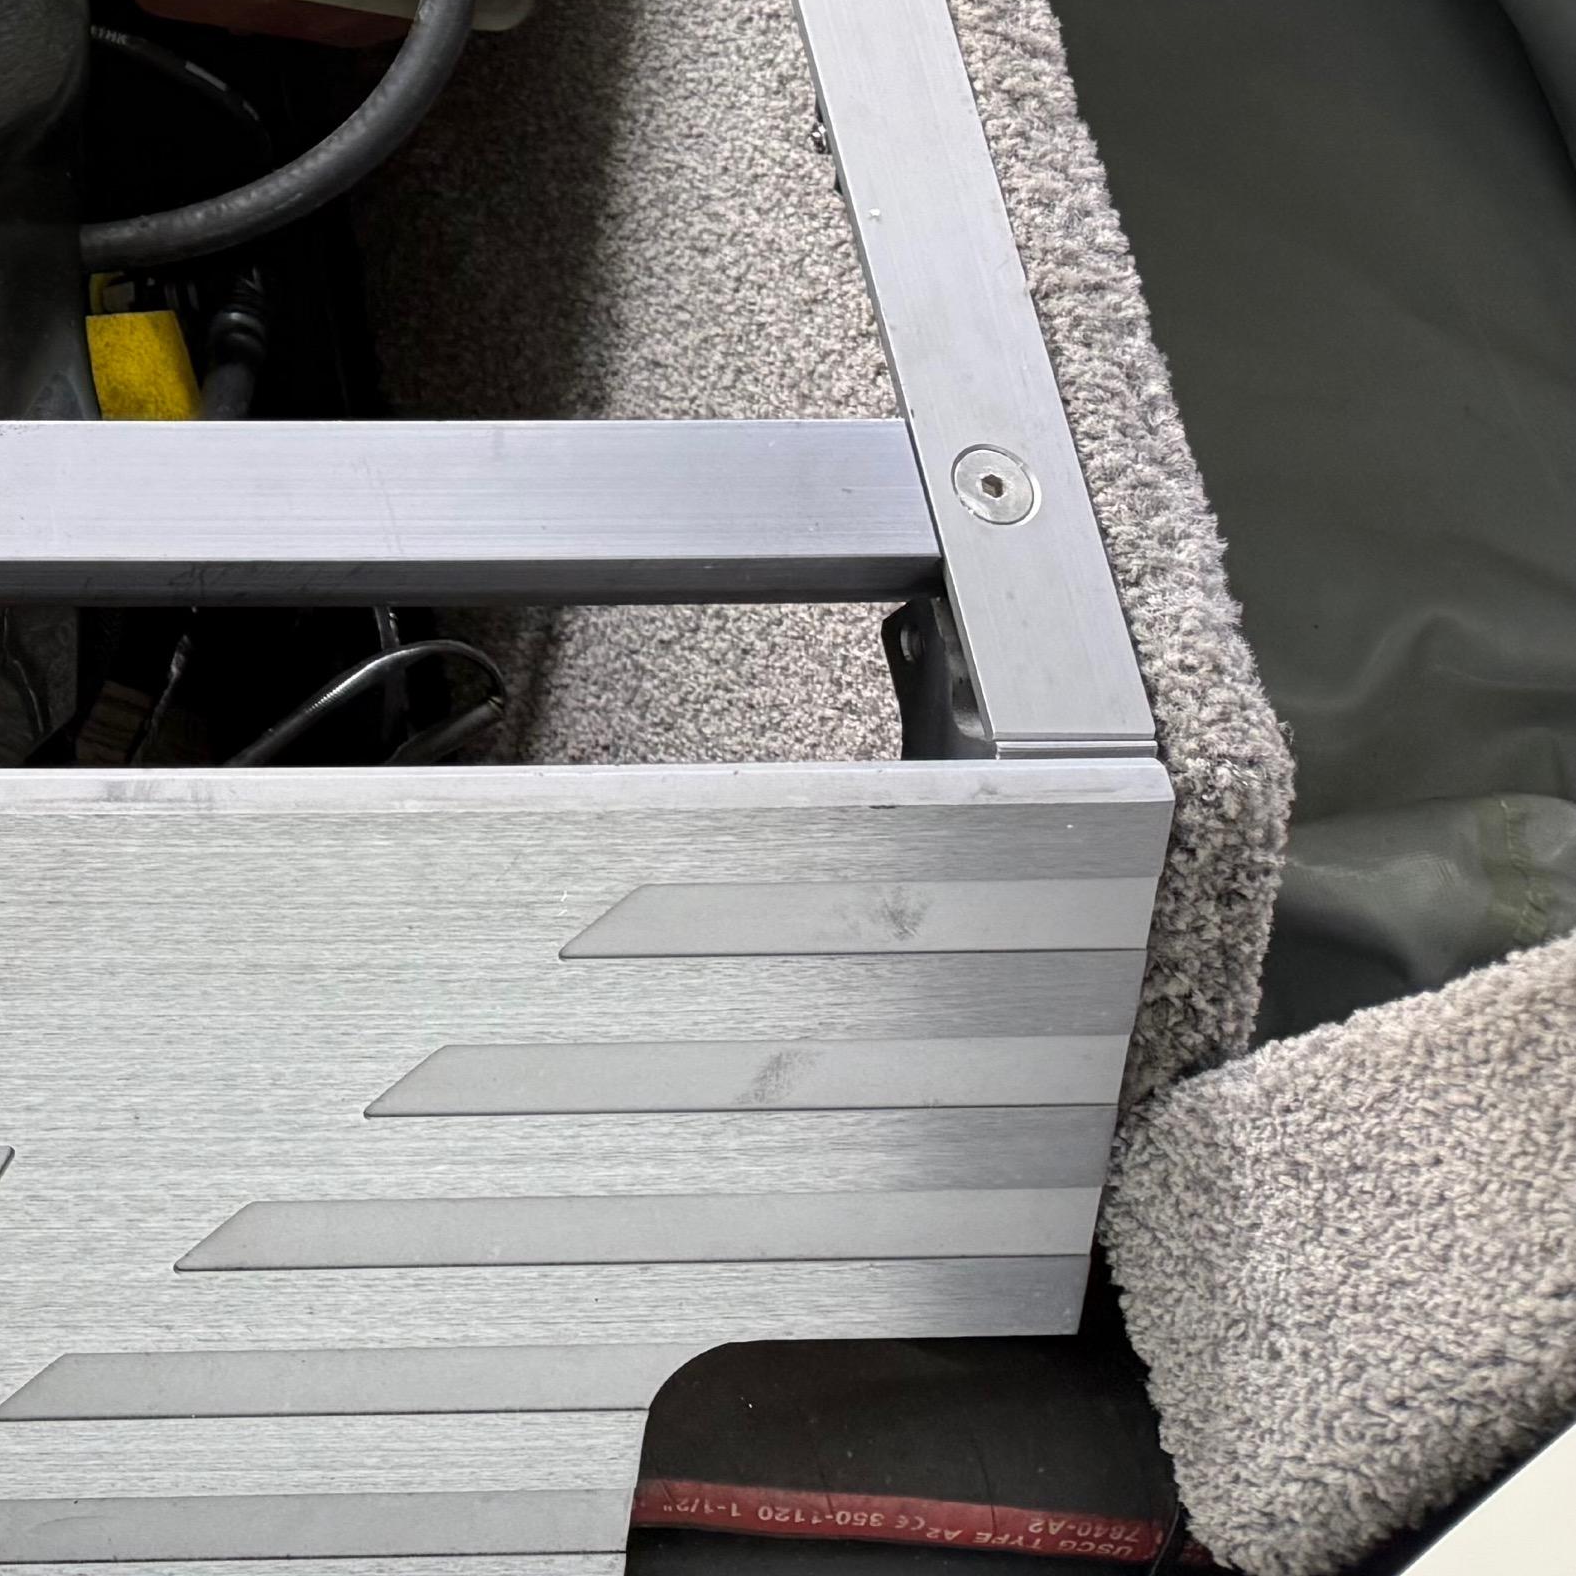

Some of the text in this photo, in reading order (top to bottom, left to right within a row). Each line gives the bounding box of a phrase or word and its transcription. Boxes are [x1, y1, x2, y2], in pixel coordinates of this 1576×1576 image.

[757, 1504, 885, 1528] 350-1120
[925, 1527, 963, 1541] A2
[973, 1530, 1044, 1550] TYPE
[1027, 1517, 1141, 1543] 7840-A2
[1058, 1539, 1135, 1557] USCG
